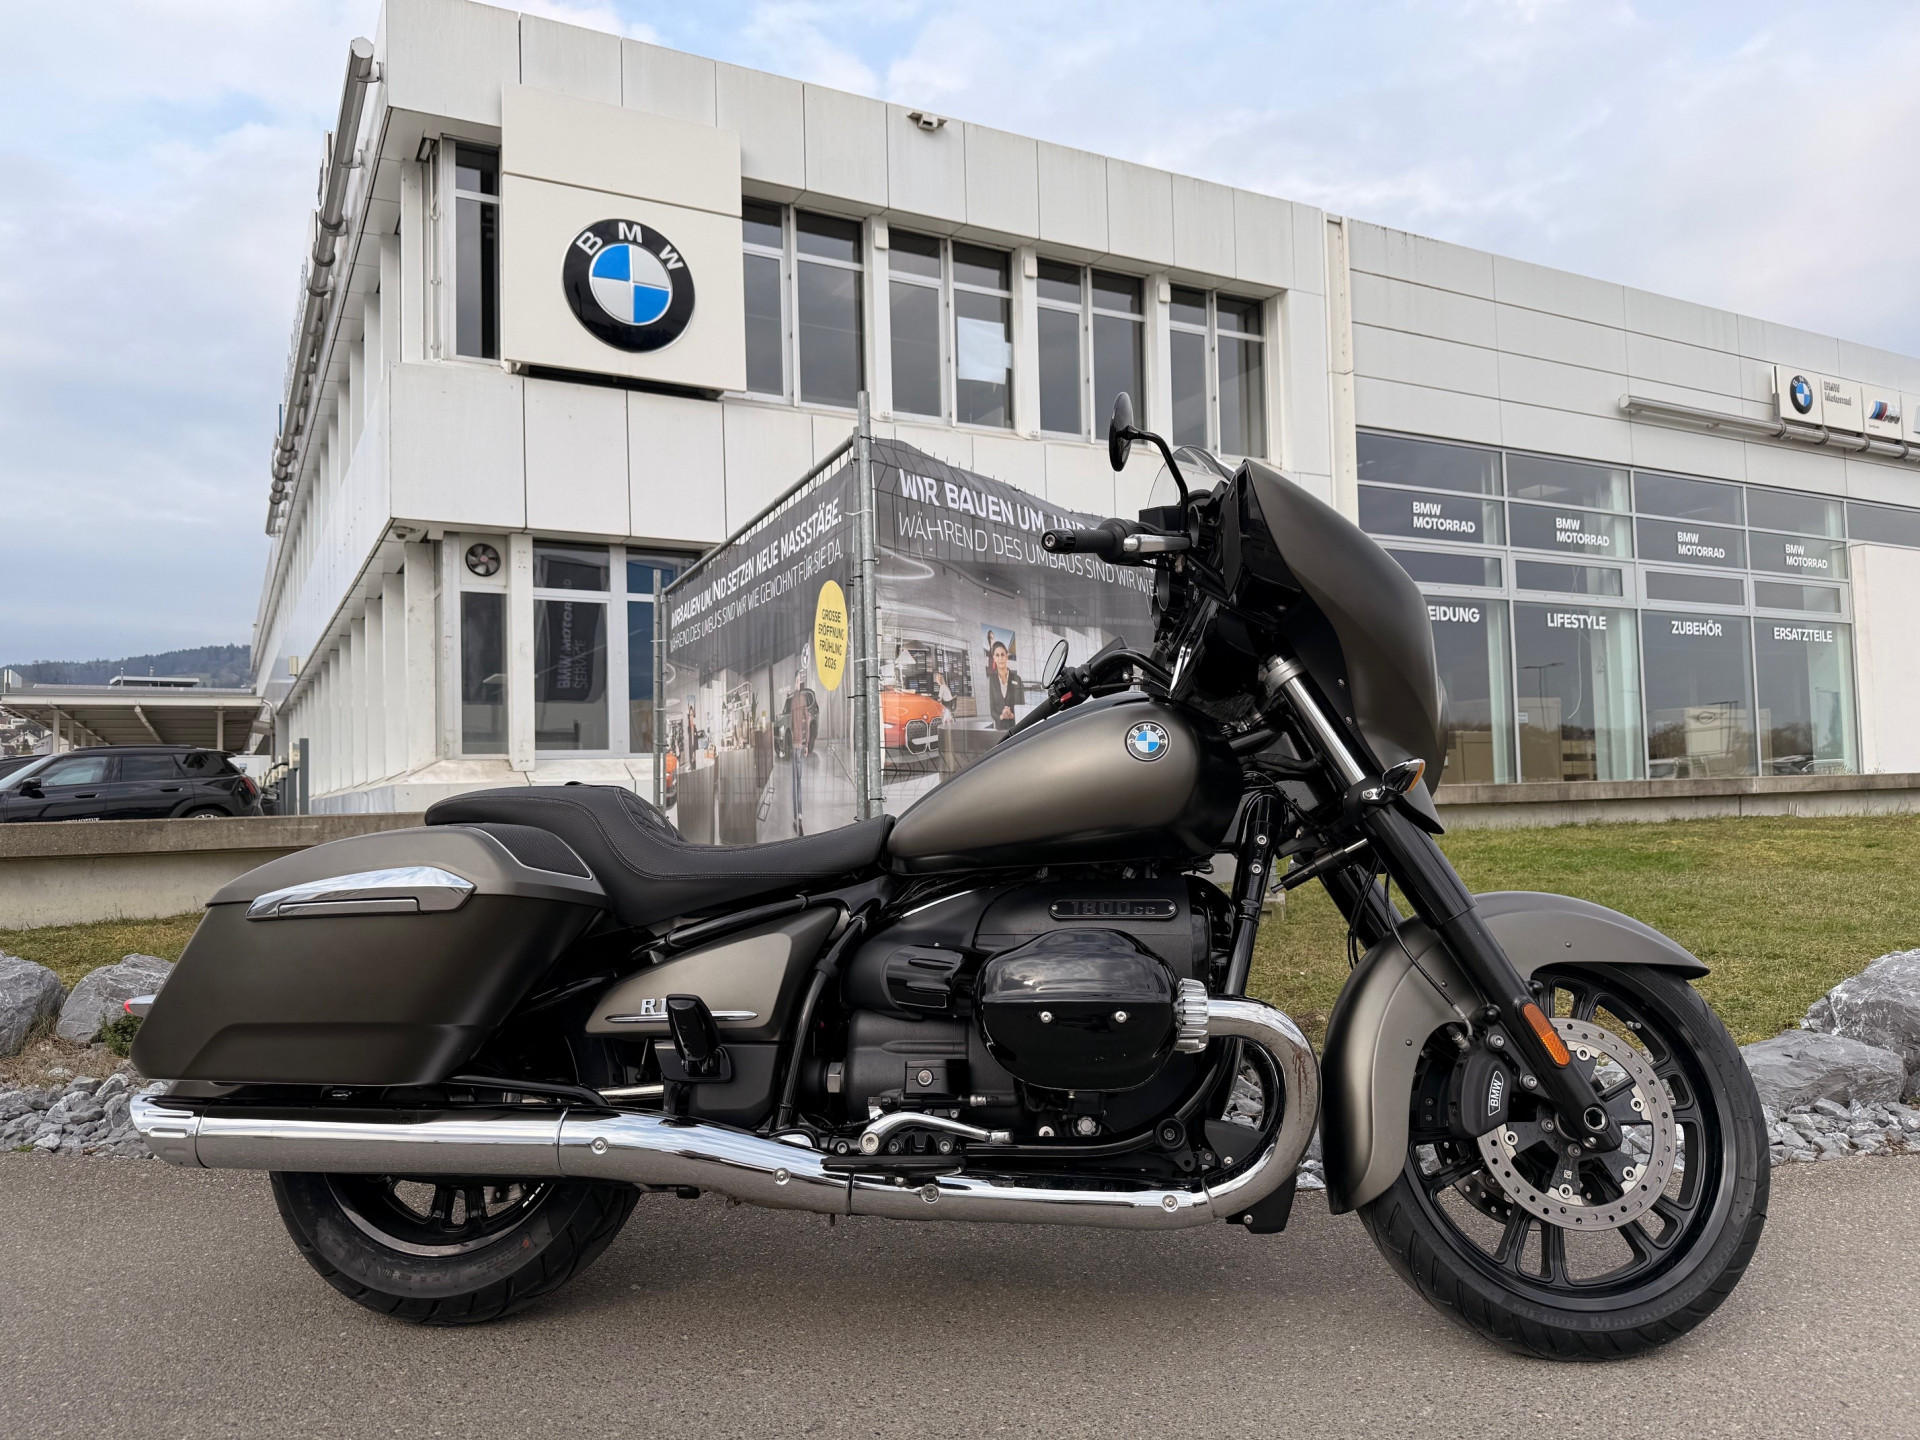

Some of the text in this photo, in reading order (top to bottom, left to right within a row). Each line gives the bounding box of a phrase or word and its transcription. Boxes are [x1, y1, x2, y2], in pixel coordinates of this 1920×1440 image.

[576, 222, 684, 270] BMW
[899, 468, 938, 506] WIR
[944, 480, 1014, 526] BAUEN
[1413, 501, 1441, 516] BMW
[1413, 517, 1475, 533] MOTORRAD
[1555, 517, 1580, 531] BMW
[1556, 531, 1610, 547] MOTORRAD
[1677, 531, 1699, 544] BMW
[712, 577, 726, 601] ND
[727, 556, 754, 595] SETZEN
[756, 540, 778, 576] NEUE
[781, 497, 842, 561] MASSSTÄBE.
[899, 511, 988, 552] WÄHREND
[992, 533, 1022, 560] DES
[1024, 542, 1083, 576] UMBAUS
[1085, 558, 1115, 583] SIND
[1115, 567, 1136, 589] WIR
[1136, 573, 1155, 596] WIE
[1678, 544, 1725, 559] MOTORRAD
[1785, 544, 1804, 556] BMW
[1786, 556, 1828, 569] MOTORRAD
[747, 587, 760, 611] WIE
[760, 566, 798, 604] GEWOHNT
[798, 554, 812, 583] FÜR
[814, 546, 826, 573] SIE
[828, 538, 844, 565] DA.
[822, 608, 841, 623] GROSSE
[1428, 605, 1480, 623] EIDUNG
[1547, 612, 1607, 630] LIFESTYLE
[818, 623, 844, 640] ERÖFFNUNG
[1671, 619, 1722, 637] ZUBEHÖR
[1774, 627, 1833, 643] ERSATZTEILE
[819, 639, 842, 656] FRÜHLING
[557, 655, 572, 689] BMW
[1131, 724, 1163, 737] BMW
[1490, 1079, 1502, 1107] BMW
